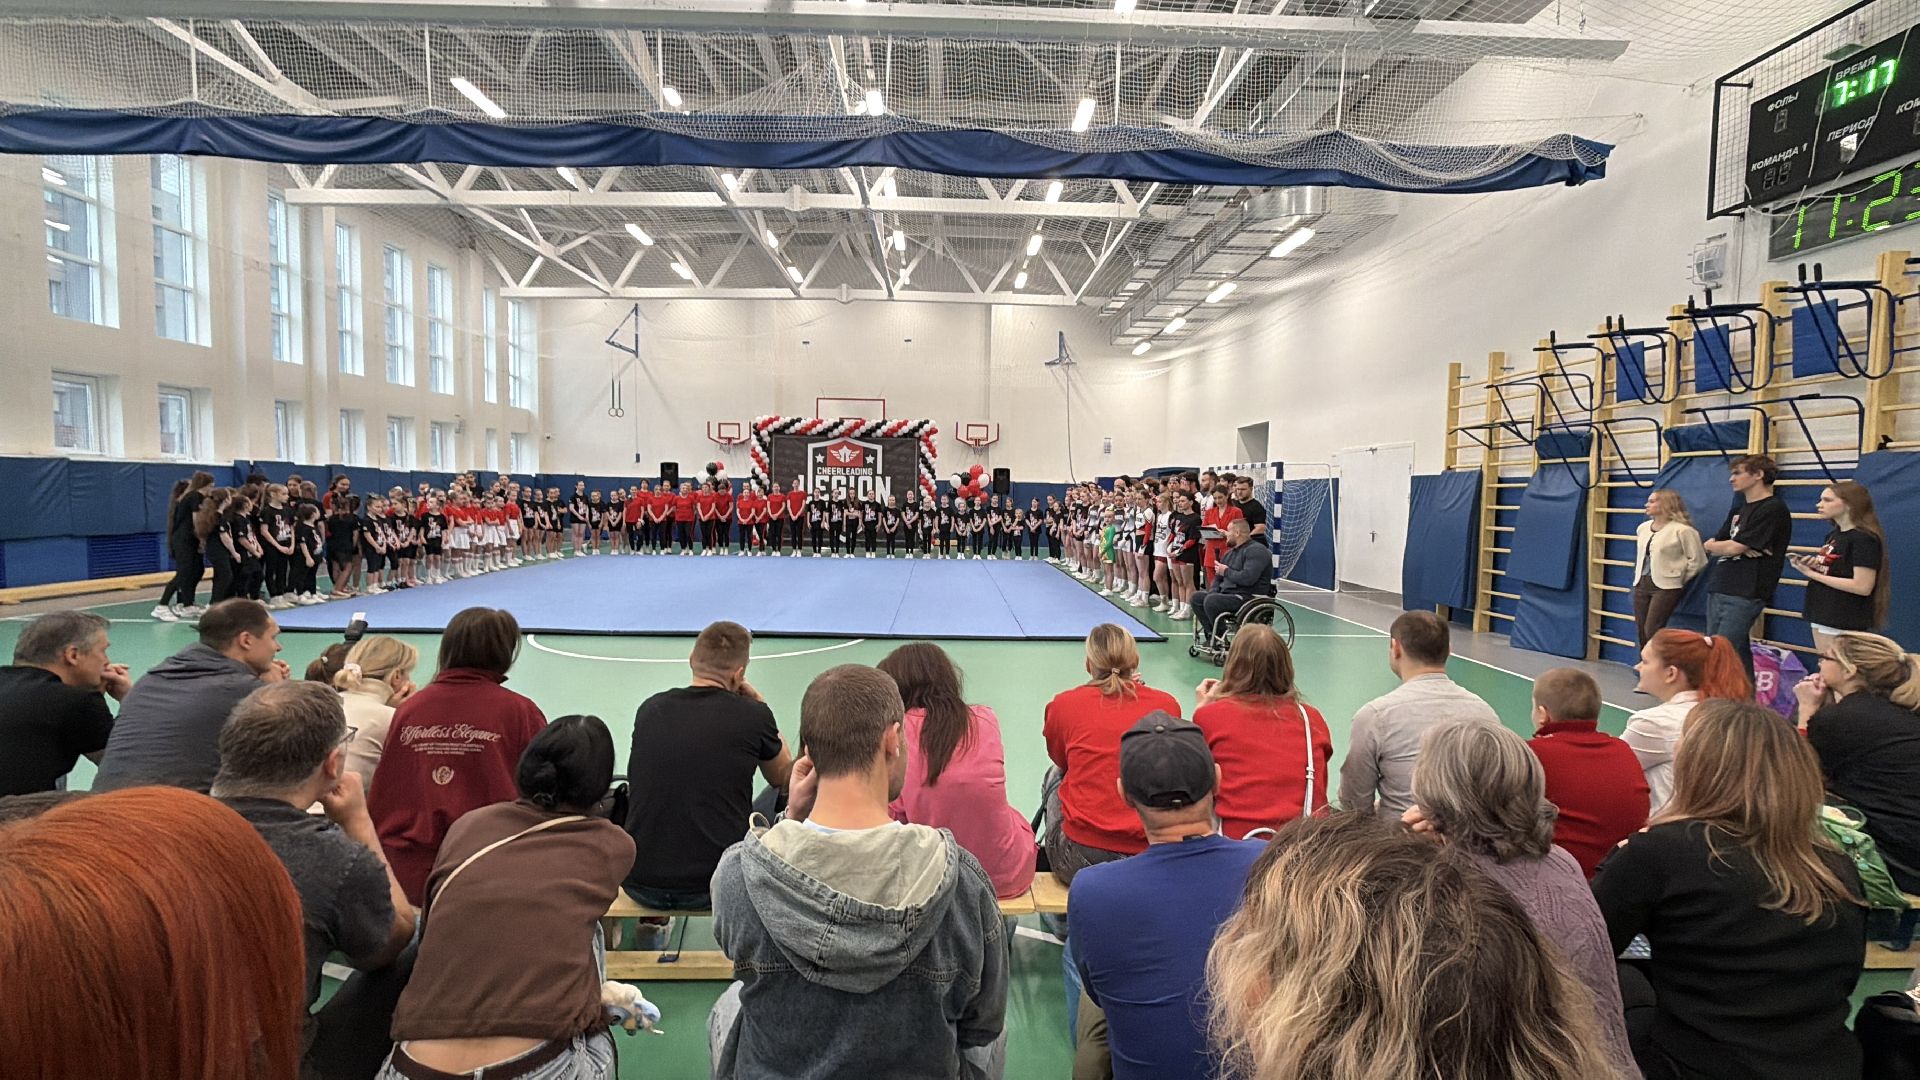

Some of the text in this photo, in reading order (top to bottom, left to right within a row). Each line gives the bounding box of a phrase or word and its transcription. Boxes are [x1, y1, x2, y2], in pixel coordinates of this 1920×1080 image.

[1835, 55, 1877, 81] ВРЕМЯ
[1834, 59, 1897, 105] 7:17
[1767, 91, 1799, 112] ФОЛЫ
[1826, 114, 1878, 142] ПЕРИОД
[1750, 142, 1808, 172] КОМАНДА 1
[817, 467, 873, 476] CHEERLEADING
[400, 723, 502, 745] Effortless Elegance
